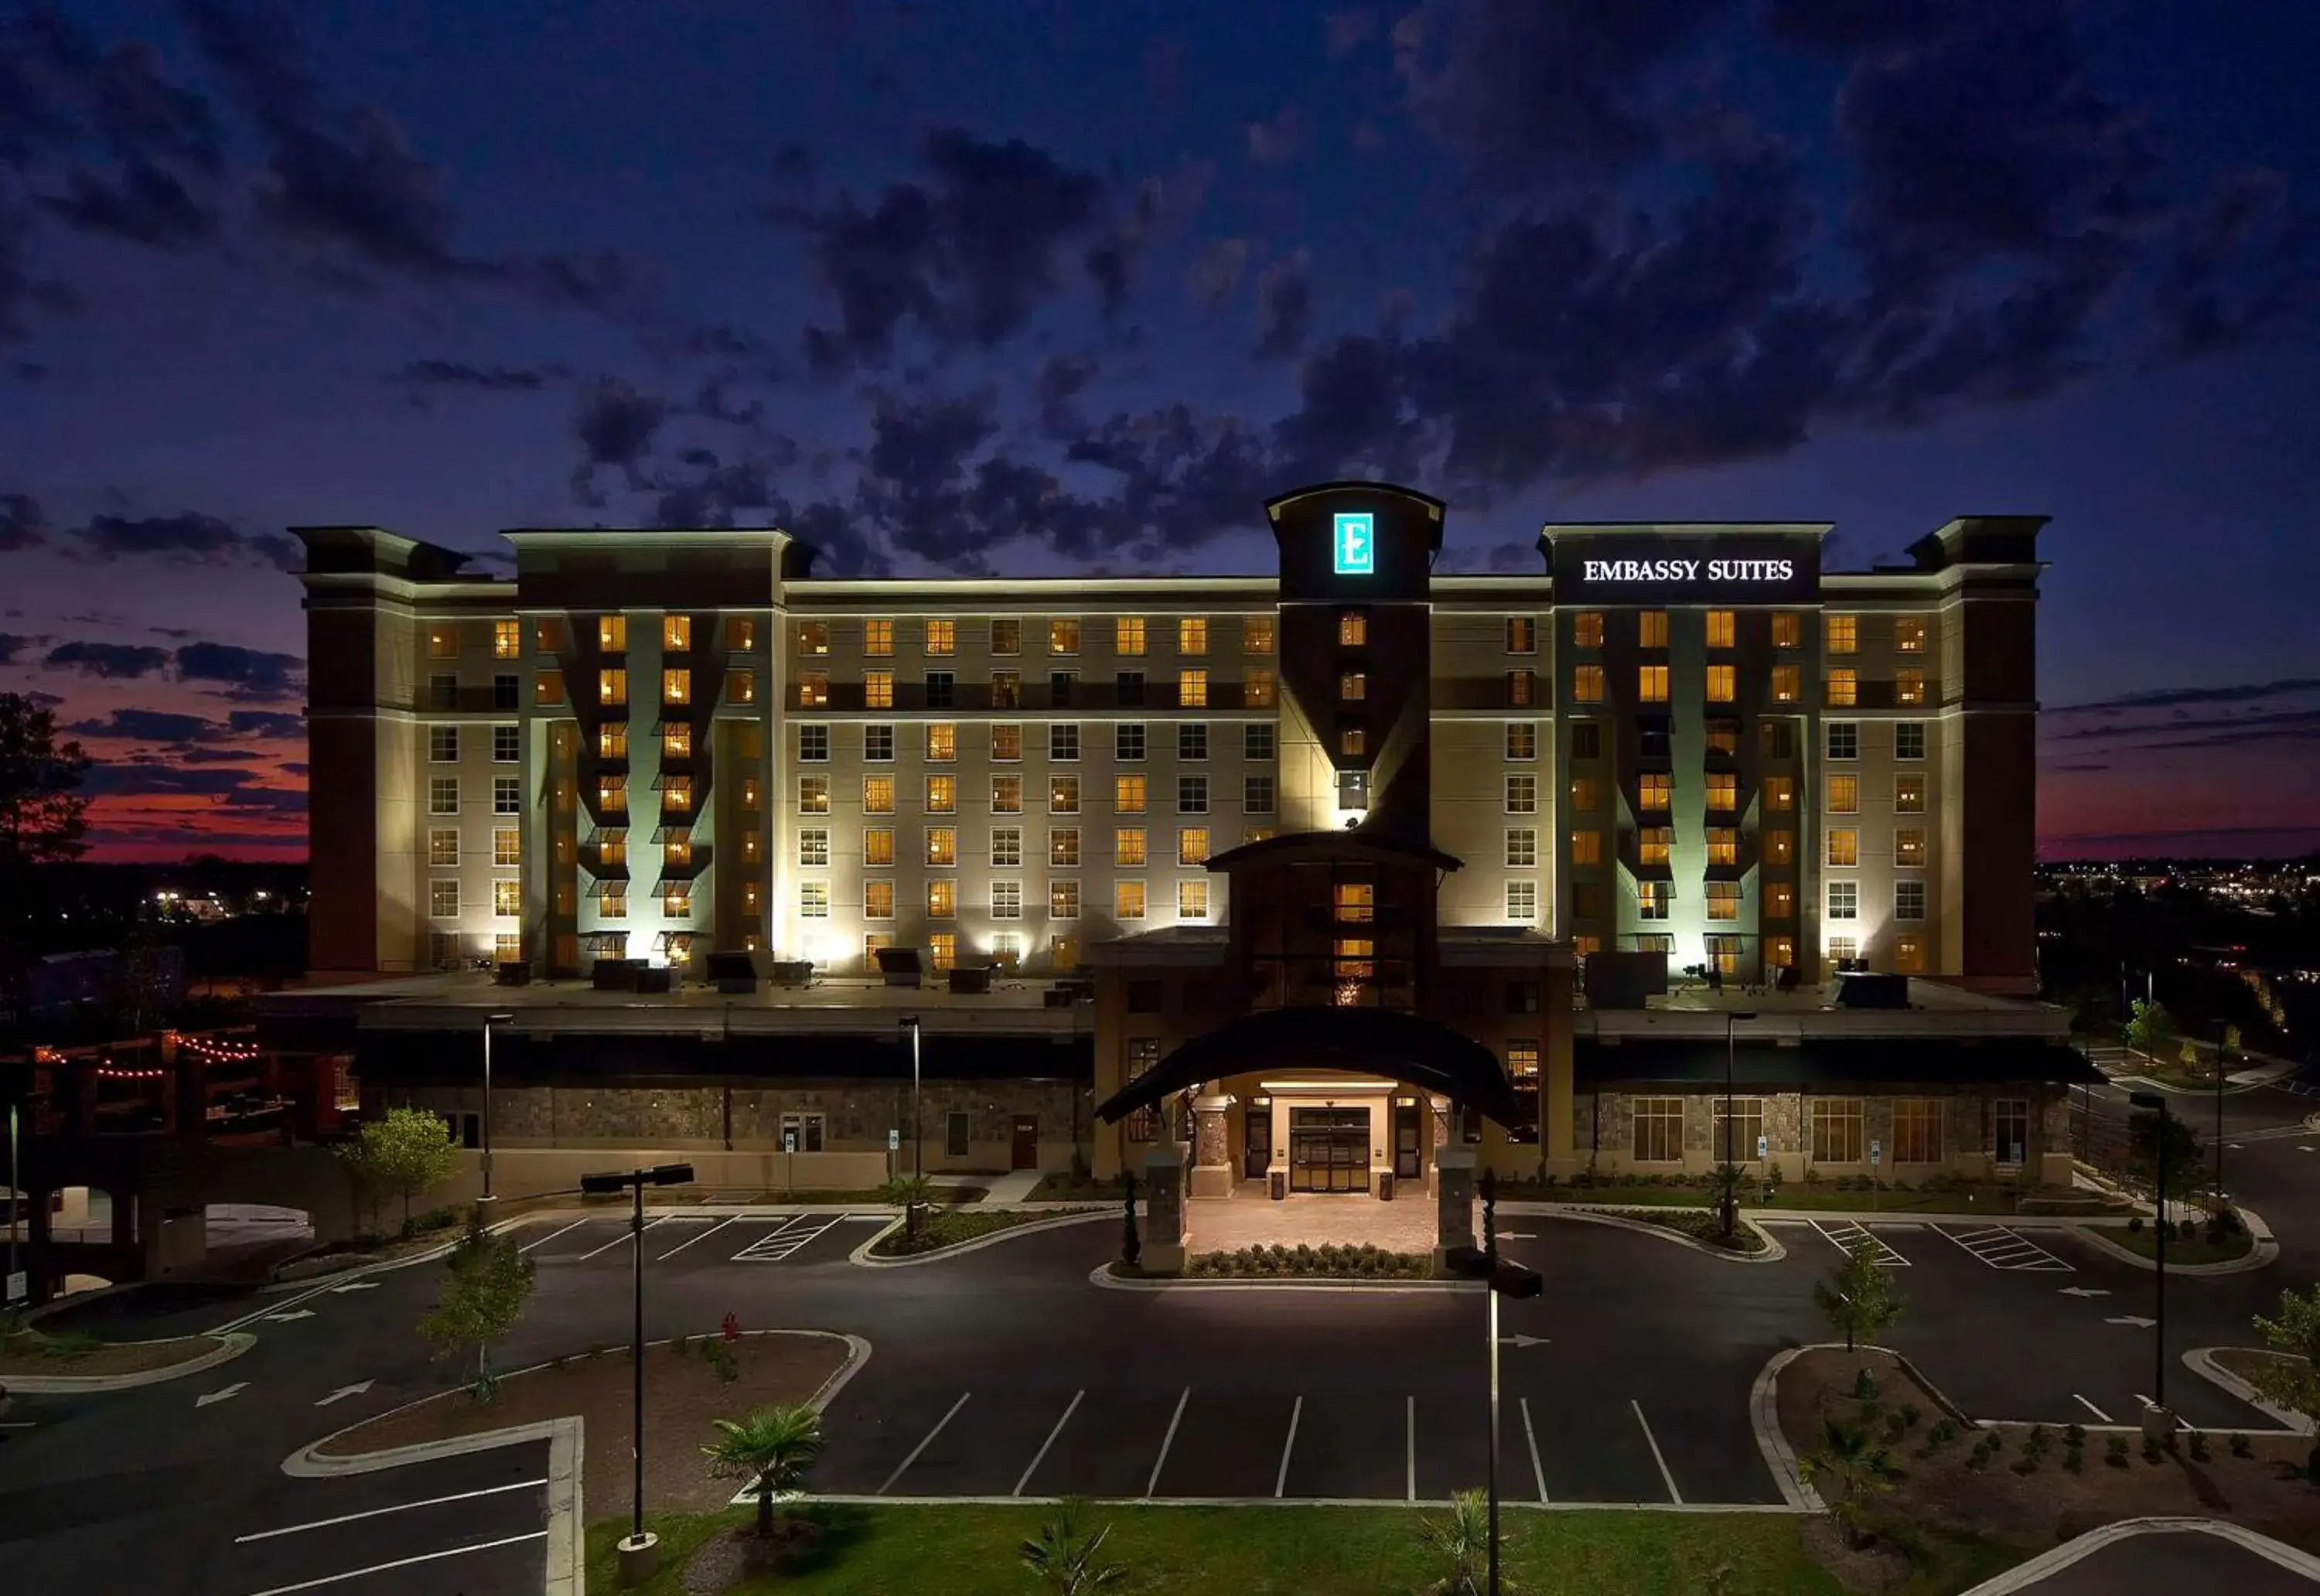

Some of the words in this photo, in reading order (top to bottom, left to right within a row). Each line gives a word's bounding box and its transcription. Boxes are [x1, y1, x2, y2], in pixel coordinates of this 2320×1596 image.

[1342, 523, 1368, 564] E
[1583, 560, 1700, 581] EMBASSY
[1708, 560, 1793, 581] SUITES
